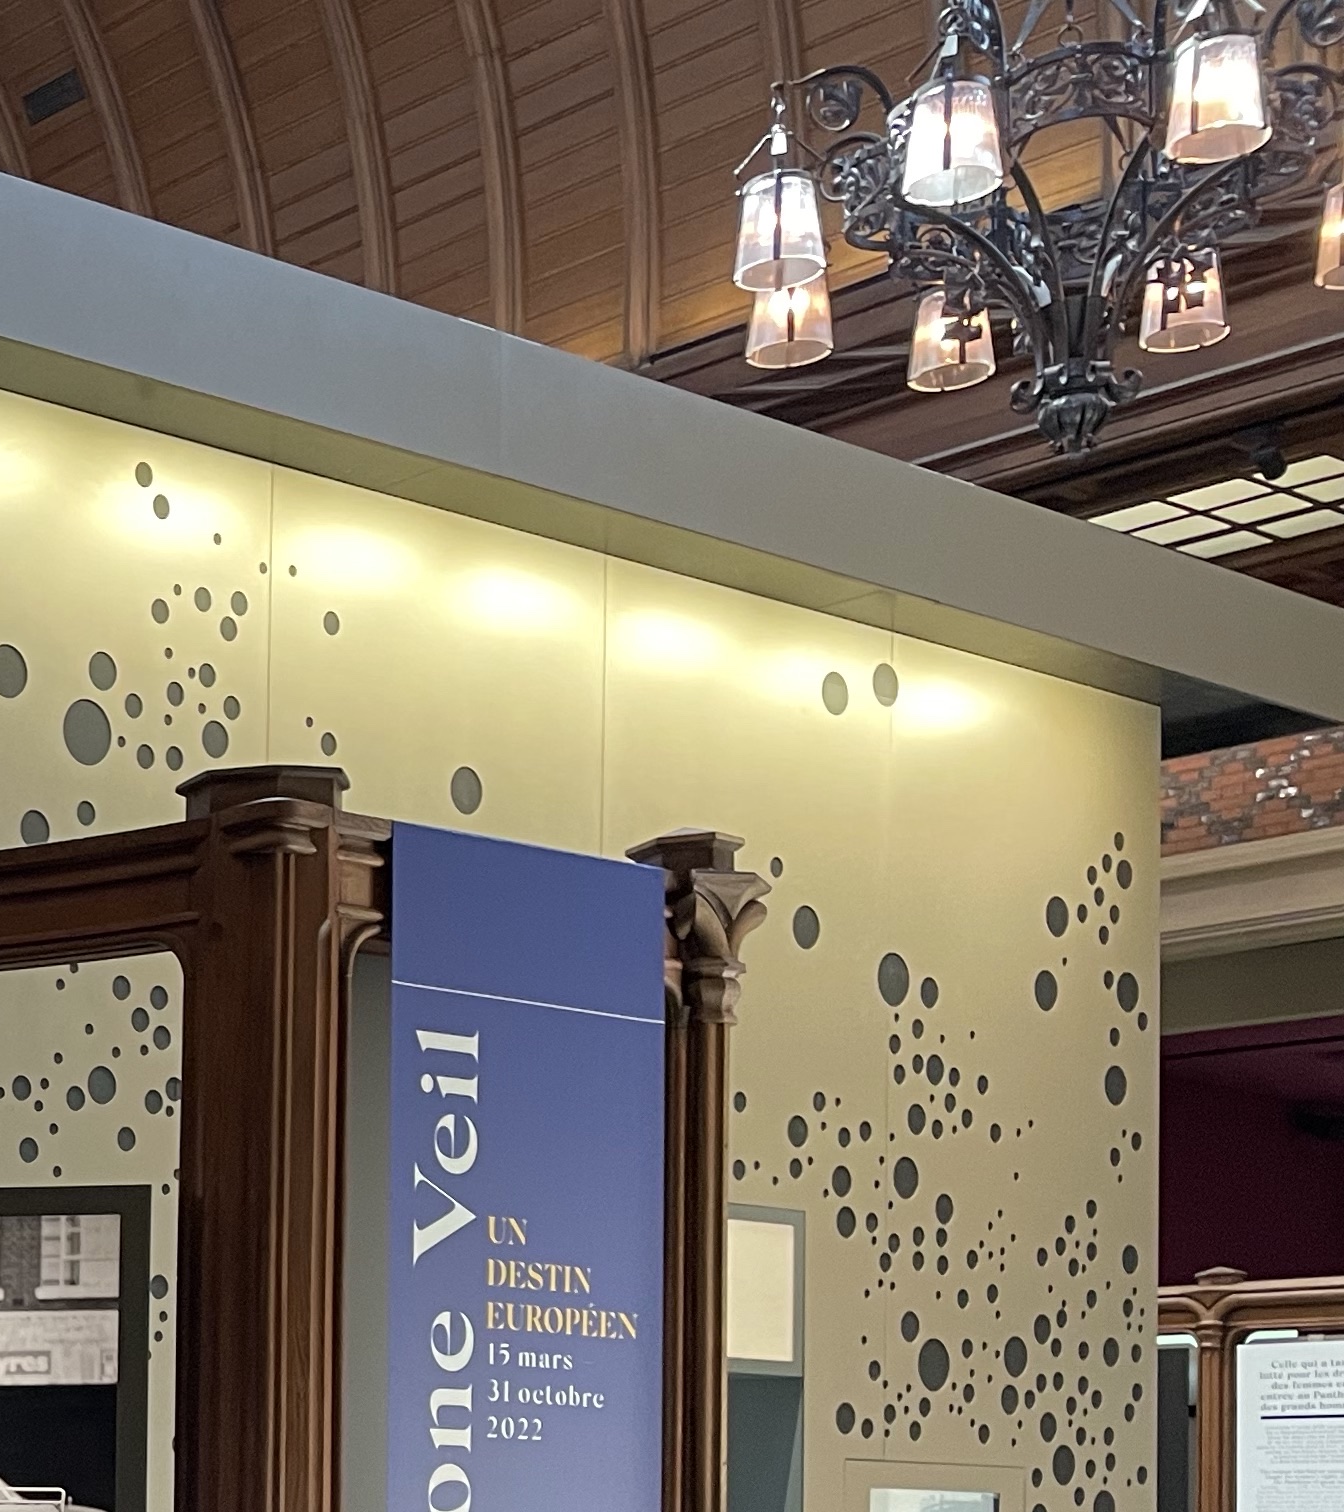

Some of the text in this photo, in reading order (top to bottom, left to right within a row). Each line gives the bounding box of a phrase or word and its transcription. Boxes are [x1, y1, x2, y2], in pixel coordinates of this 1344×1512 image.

[413, 1027, 480, 1266] Veil
[487, 1215, 528, 1245] UN
[487, 1258, 591, 1294] DESTIN
[486, 1301, 639, 1339] EUROPÉEN
[488, 1342, 573, 1370] 15 mars
[487, 1378, 605, 1409] 31 octobre
[487, 1416, 543, 1441] 2022
